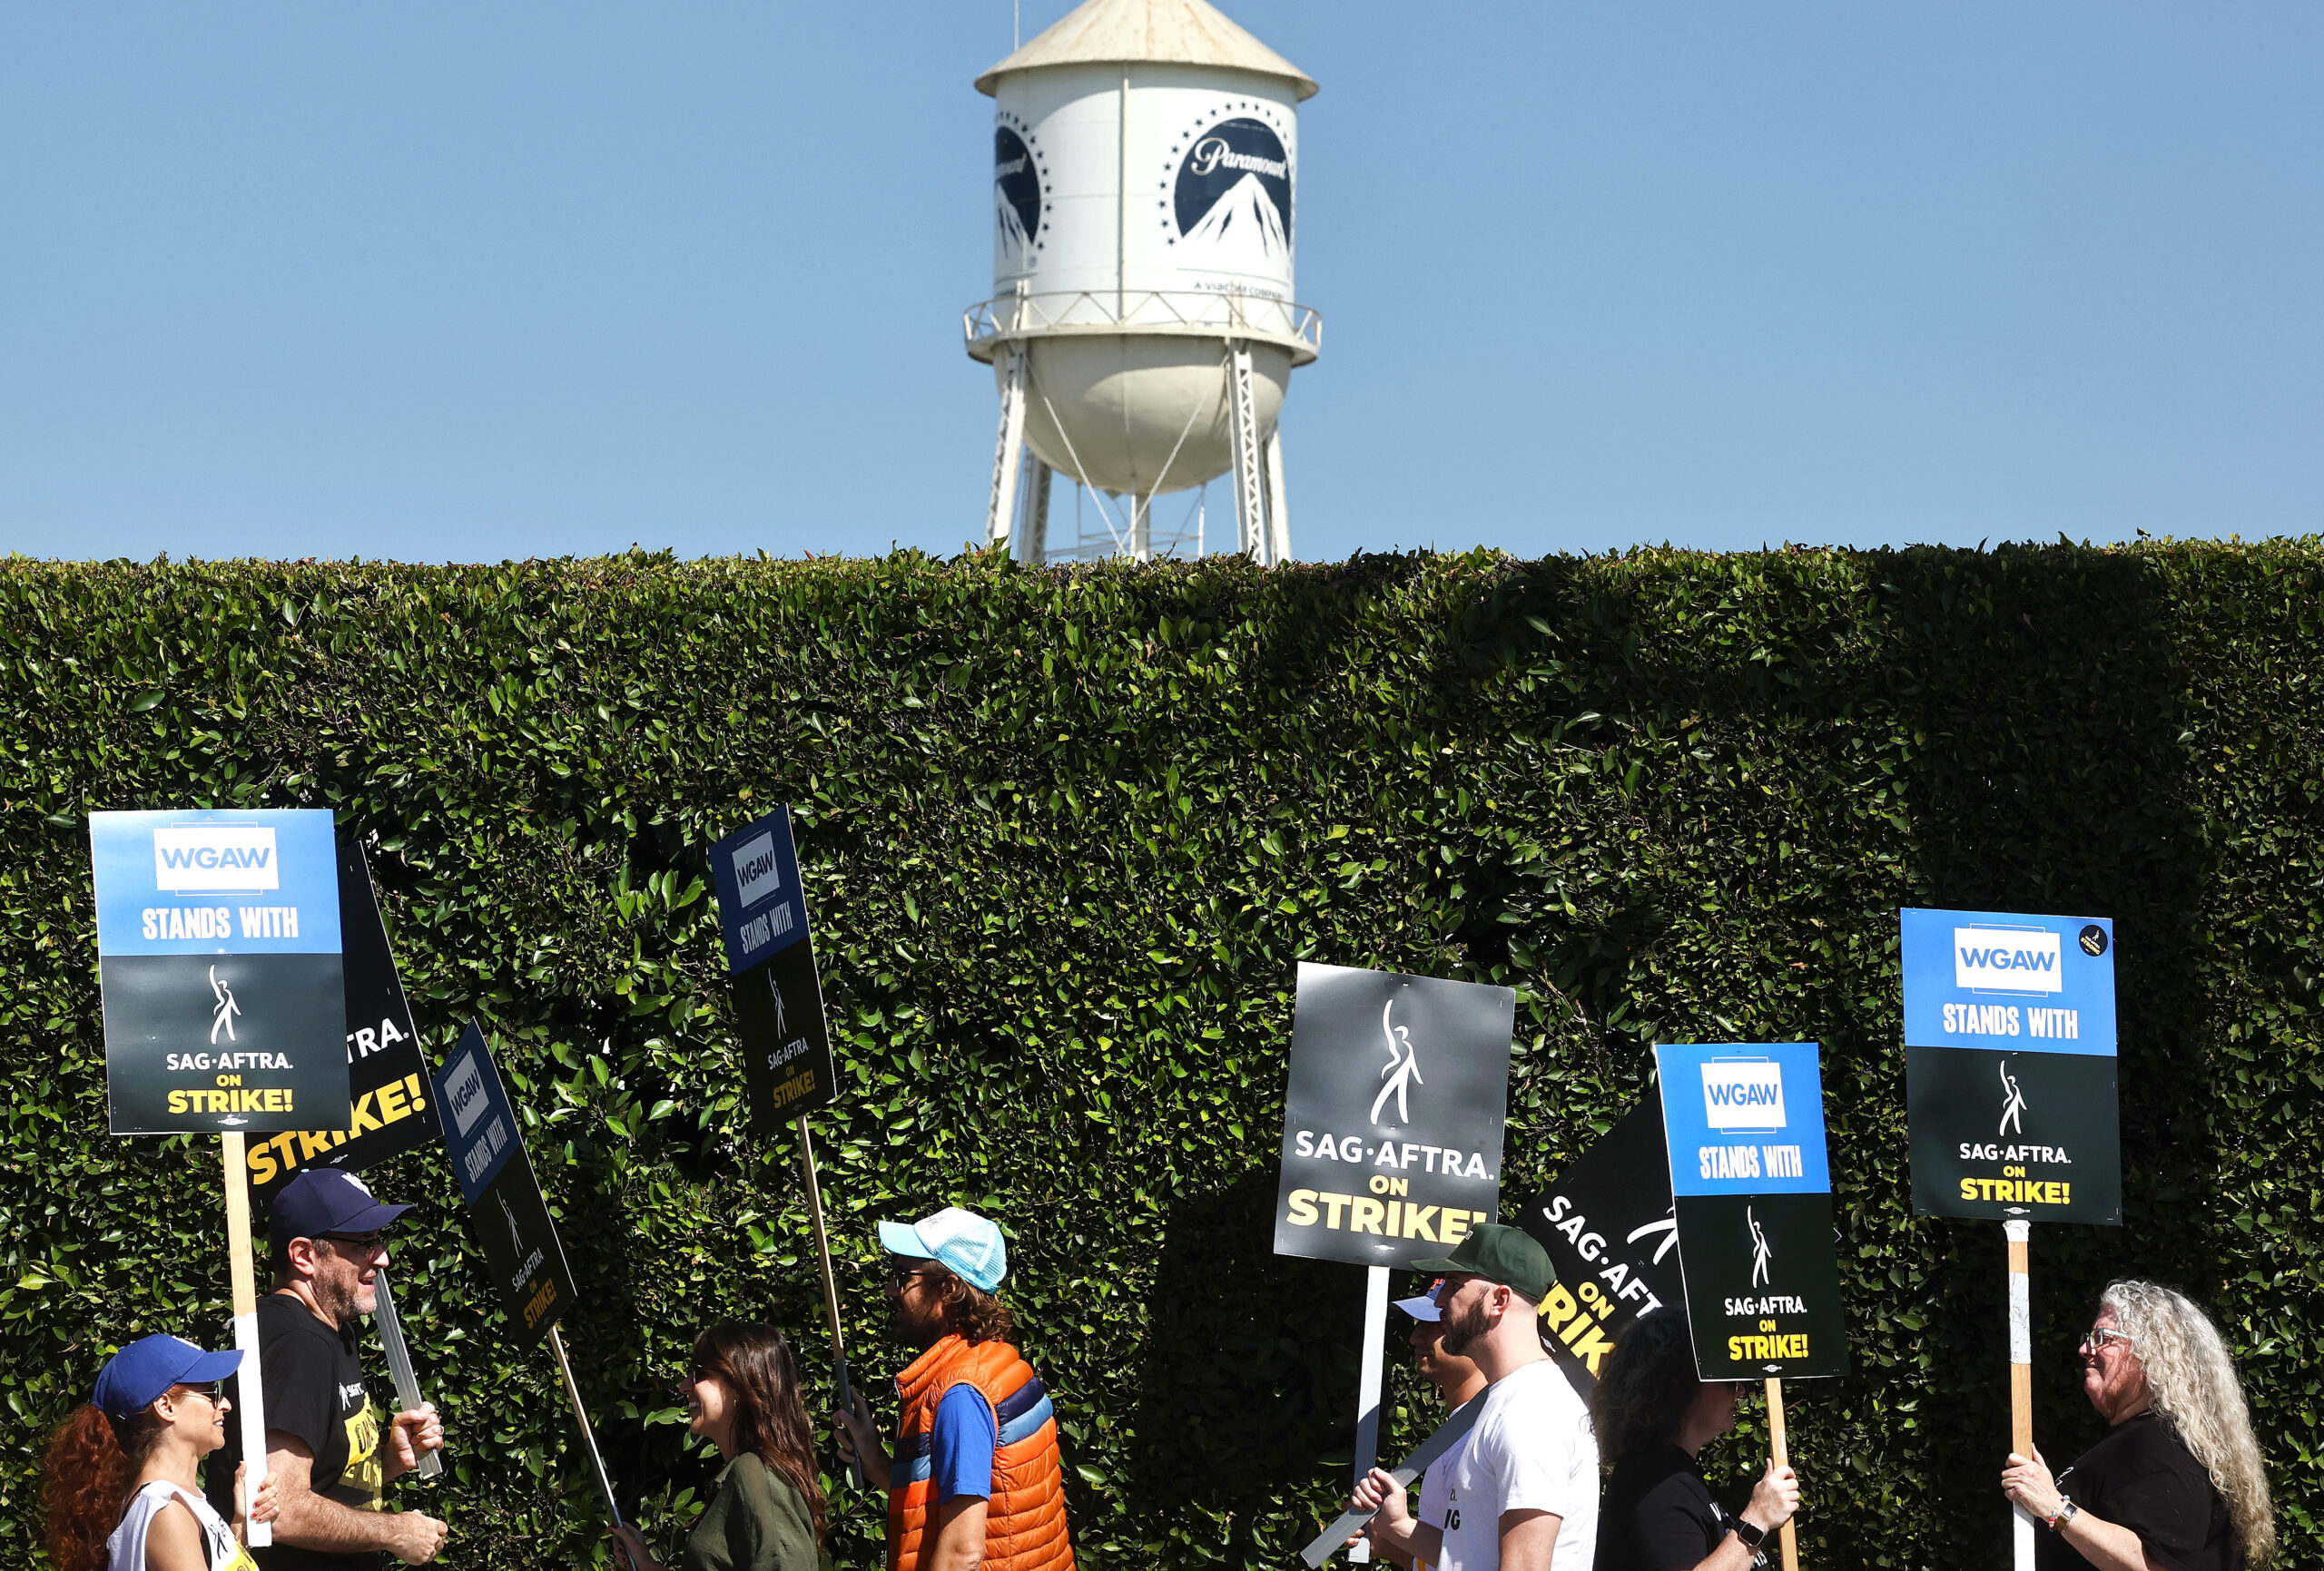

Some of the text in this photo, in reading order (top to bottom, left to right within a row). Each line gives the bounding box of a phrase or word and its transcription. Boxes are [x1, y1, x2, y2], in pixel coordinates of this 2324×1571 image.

[1191, 137, 1287, 181] Paramount
[161, 847, 270, 869] WGAW
[736, 850, 773, 887] WGAW
[142, 907, 299, 939] STANDS WITH
[740, 901, 793, 955] STANDS WITH
[1960, 947, 2055, 972] WGAW
[1943, 1003, 2079, 1039] STANDS WITH
[216, 1074, 241, 1086] ON
[786, 1065, 795, 1078] ON
[167, 1089, 294, 1114] STRIKE!
[451, 1068, 480, 1117] WGAW
[773, 1069, 816, 1109] STRIKE!
[1708, 1083, 1777, 1106] WGAW
[464, 1114, 508, 1183] STANDS WITH
[1699, 1144, 1803, 1179] STANDS WITH
[1369, 1174, 1408, 1197] ON
[2003, 1165, 2025, 1178] ON
[1960, 1177, 2071, 1205] STRIKE!
[529, 1279, 537, 1293] ON
[1579, 1281, 1615, 1321] ON
[524, 1278, 556, 1330] STRIKE!
[1538, 1279, 1616, 1380] RIK
[1759, 1320, 1776, 1332] ON
[1728, 1333, 1808, 1360] STRIKE!
